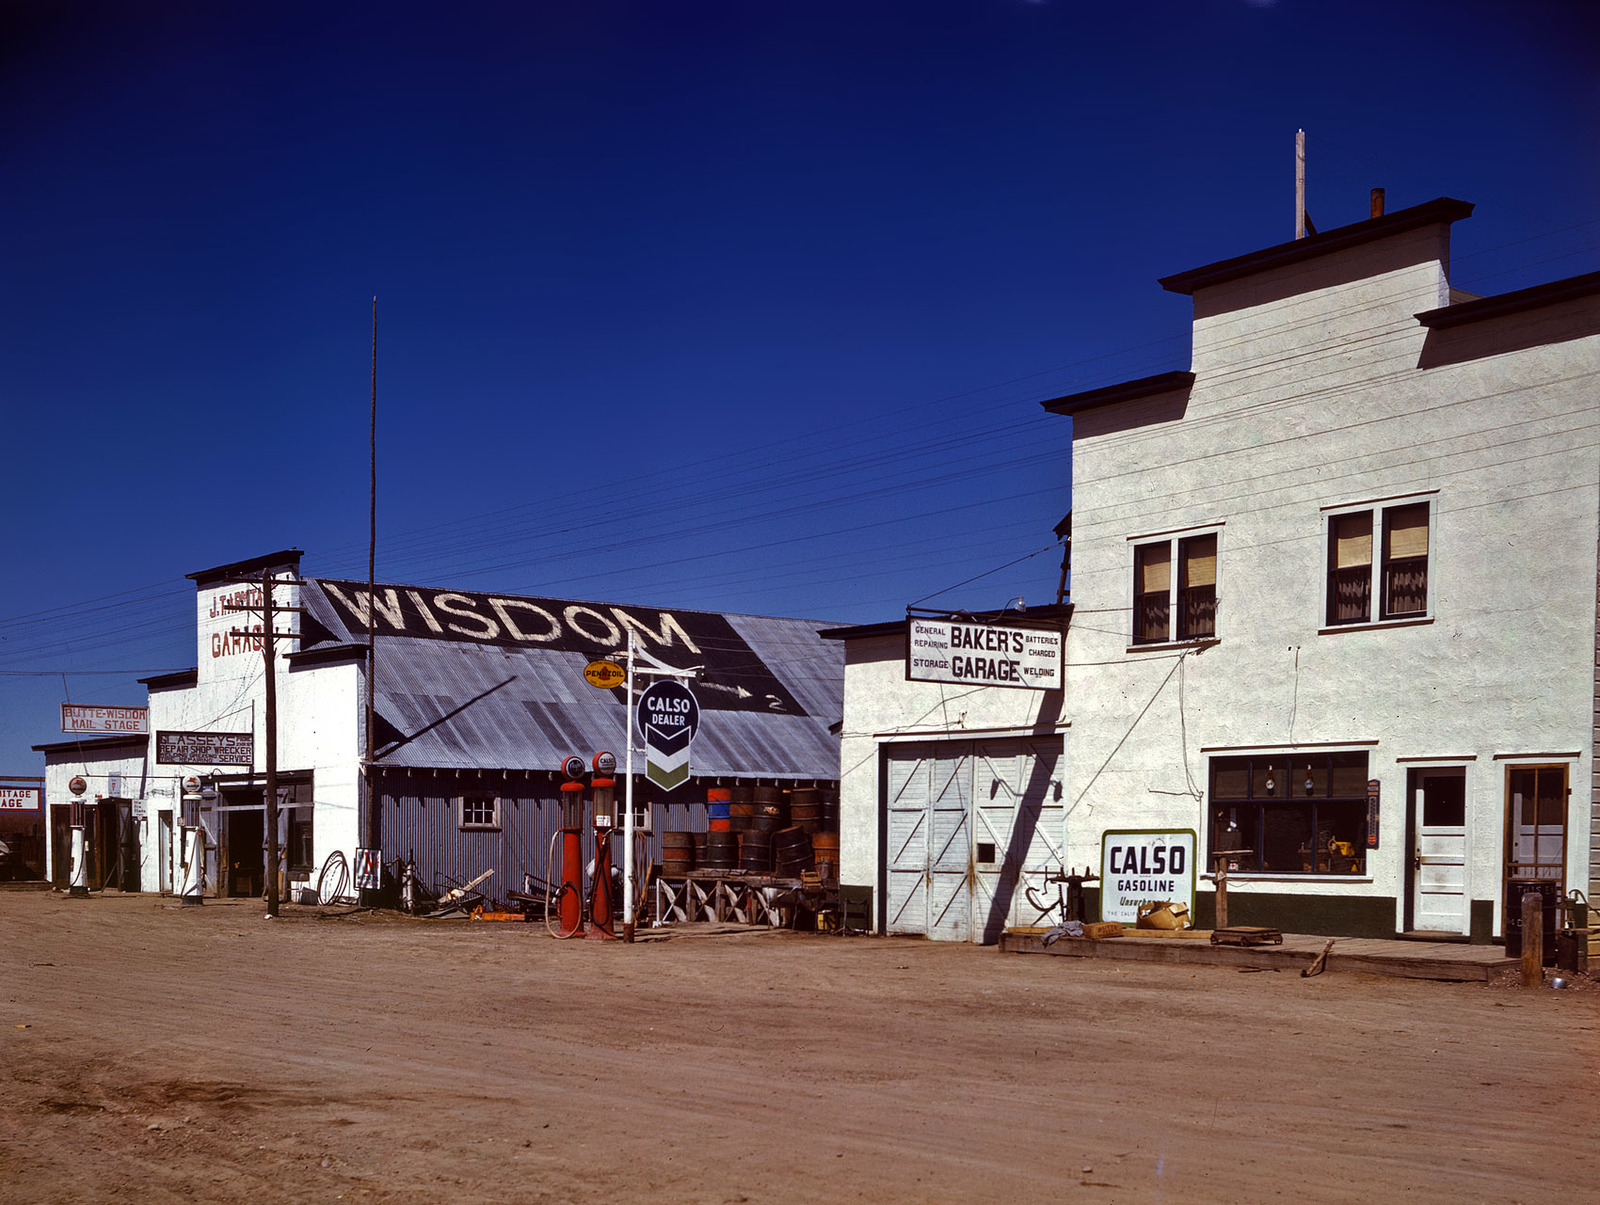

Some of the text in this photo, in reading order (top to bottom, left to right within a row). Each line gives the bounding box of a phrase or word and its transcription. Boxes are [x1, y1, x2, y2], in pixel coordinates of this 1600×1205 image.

[323, 583, 702, 654] WISDOM
[915, 626, 946, 636] GENERAL
[211, 624, 266, 658] GARAG
[914, 639, 949, 650] REPAIRING
[951, 626, 1024, 654] BAKER'S
[1025, 635, 1059, 646] BATTERIES
[1028, 649, 1056, 658] CHARGED
[913, 658, 949, 669] STORAGE
[952, 656, 1020, 682] GARAGE
[586, 670, 624, 678] PENNZOIL
[1023, 667, 1055, 677] WELDING
[647, 696, 690, 713] CALSO
[65, 707, 146, 720] BUTTE-WISDOM
[72, 719, 140, 730] MAIL STAGE
[652, 713, 685, 726] DEALER
[160, 745, 251, 755] REPAIR SHOP WRECKER
[219, 755, 252, 763] SERVICE
[1110, 846, 1185, 874] CALSO
[1117, 880, 1174, 892] GASOLINE
